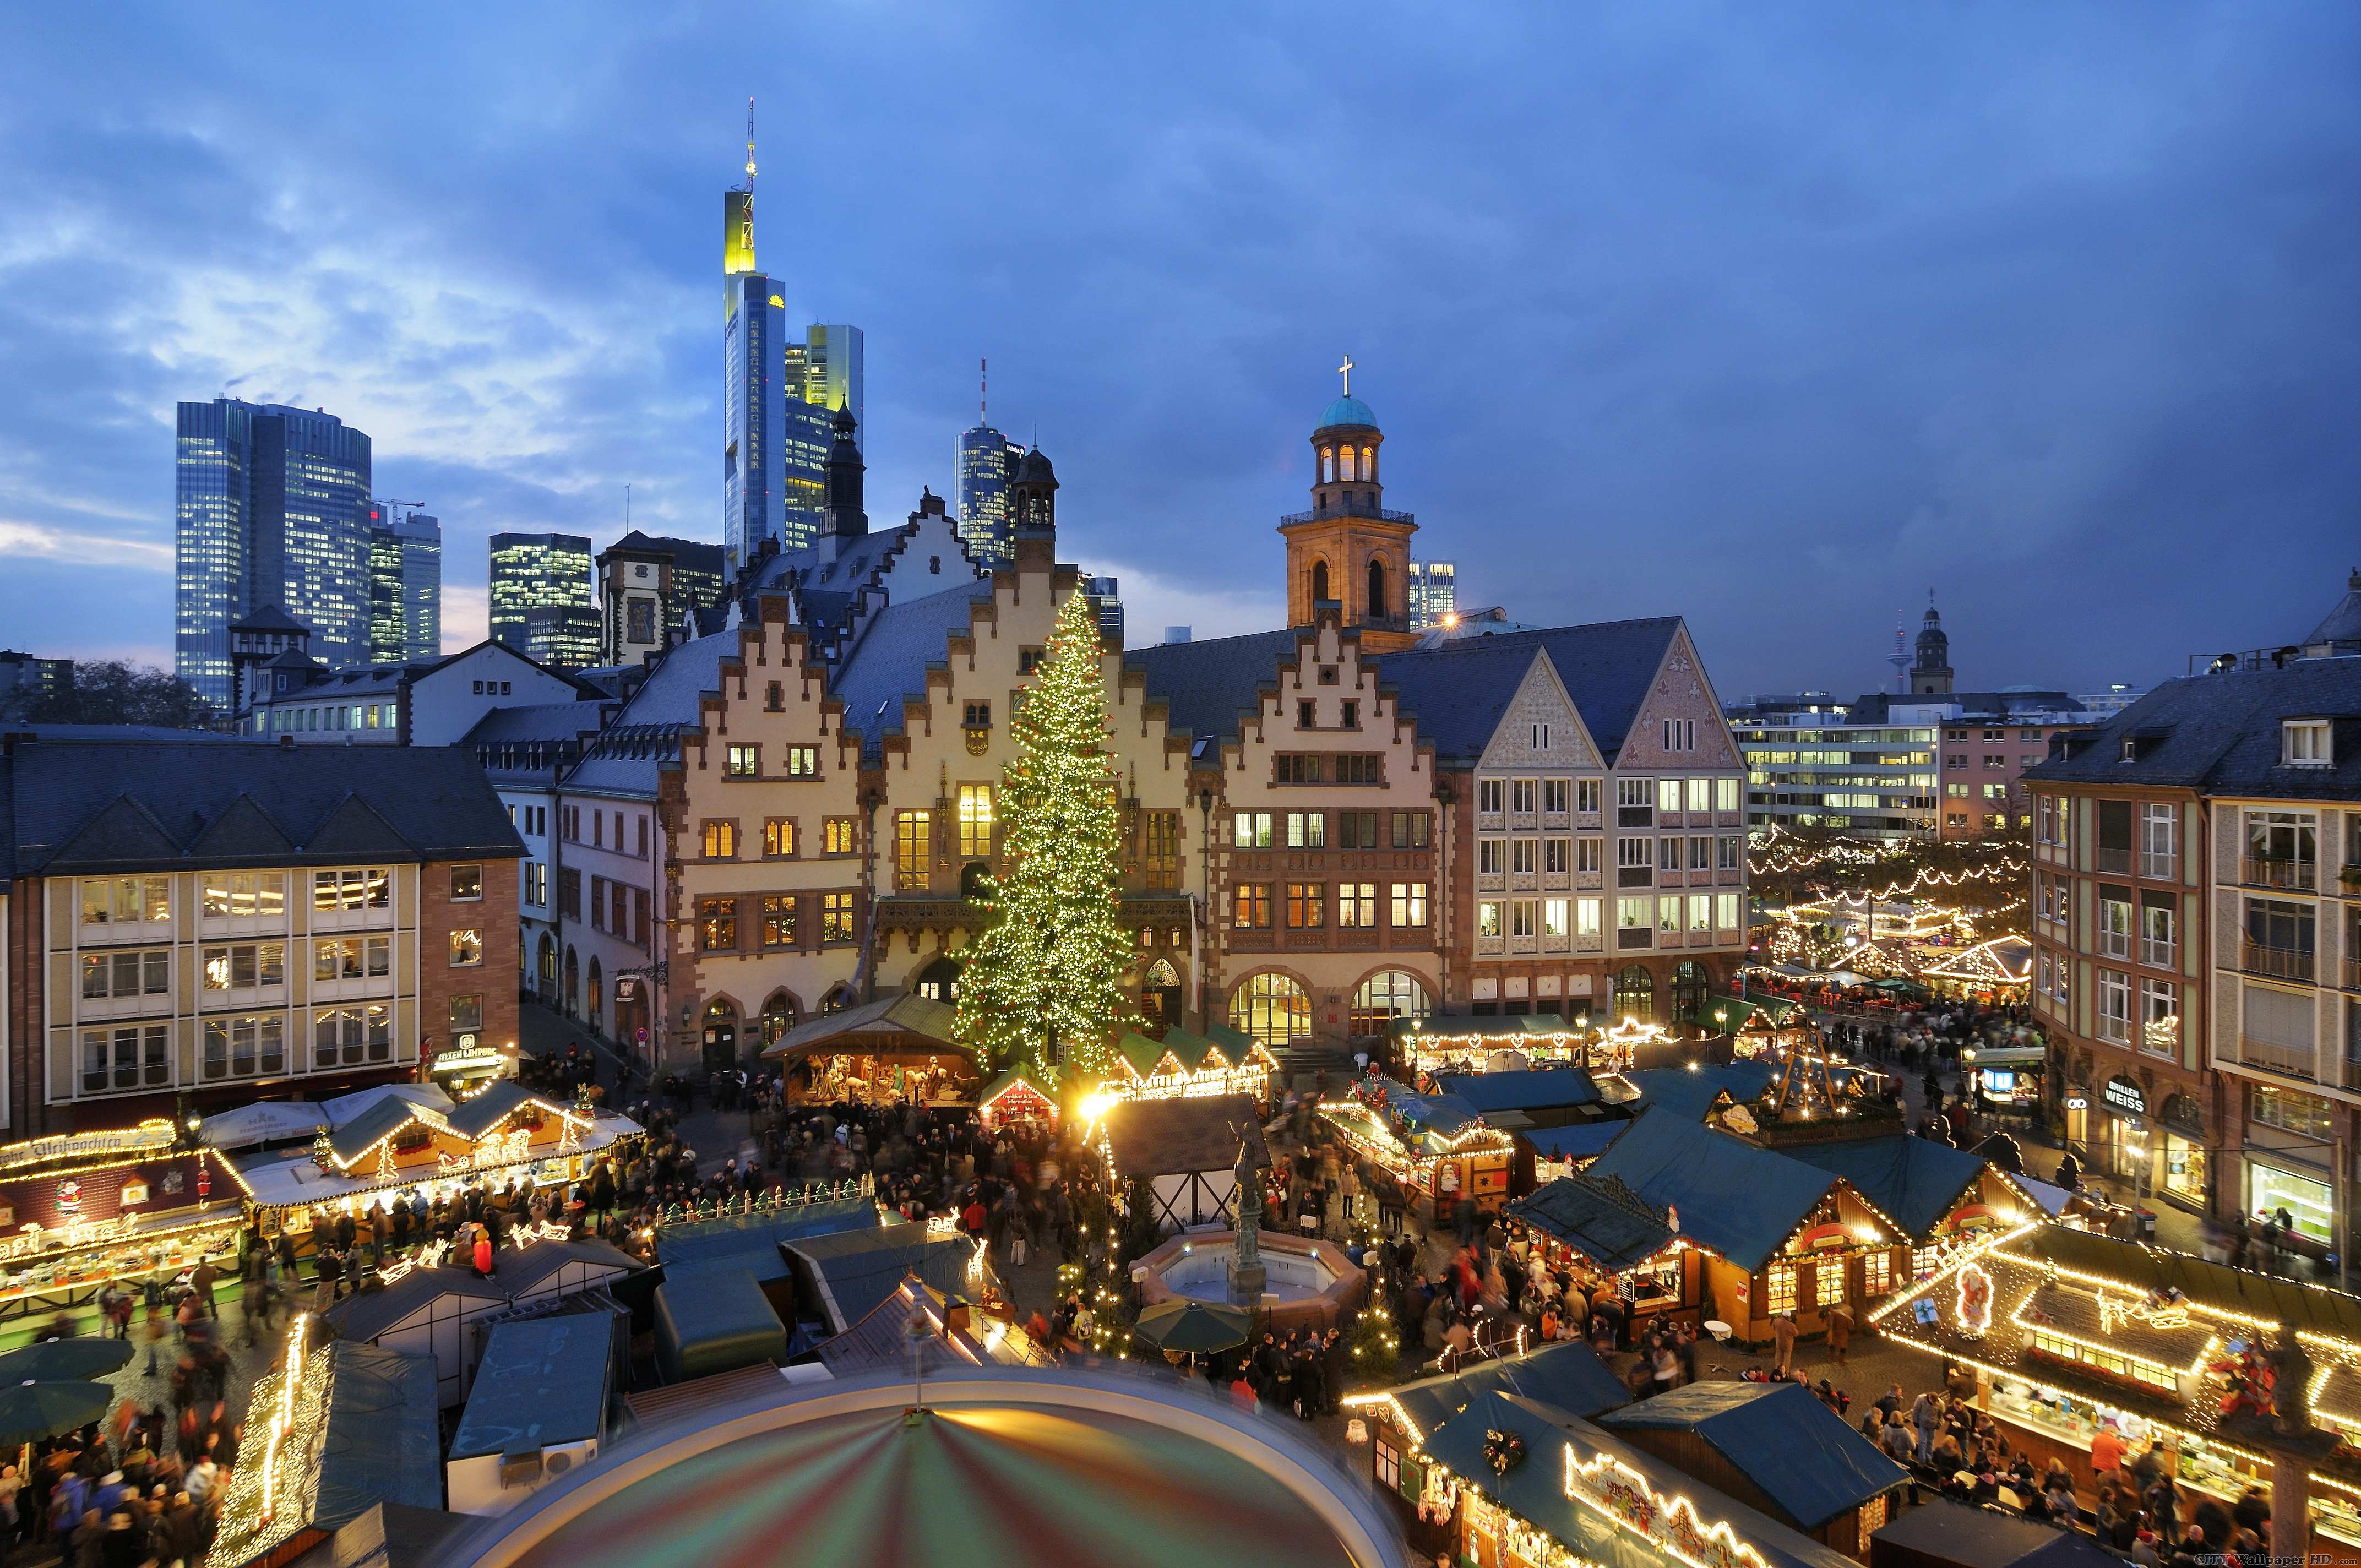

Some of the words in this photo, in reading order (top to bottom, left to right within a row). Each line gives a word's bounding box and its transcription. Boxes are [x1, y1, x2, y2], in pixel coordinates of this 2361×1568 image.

[1996, 1075, 2010, 1088] U
[2109, 1081, 2140, 1098] BRILLEN
[2106, 1089, 2144, 1112] WEISS
